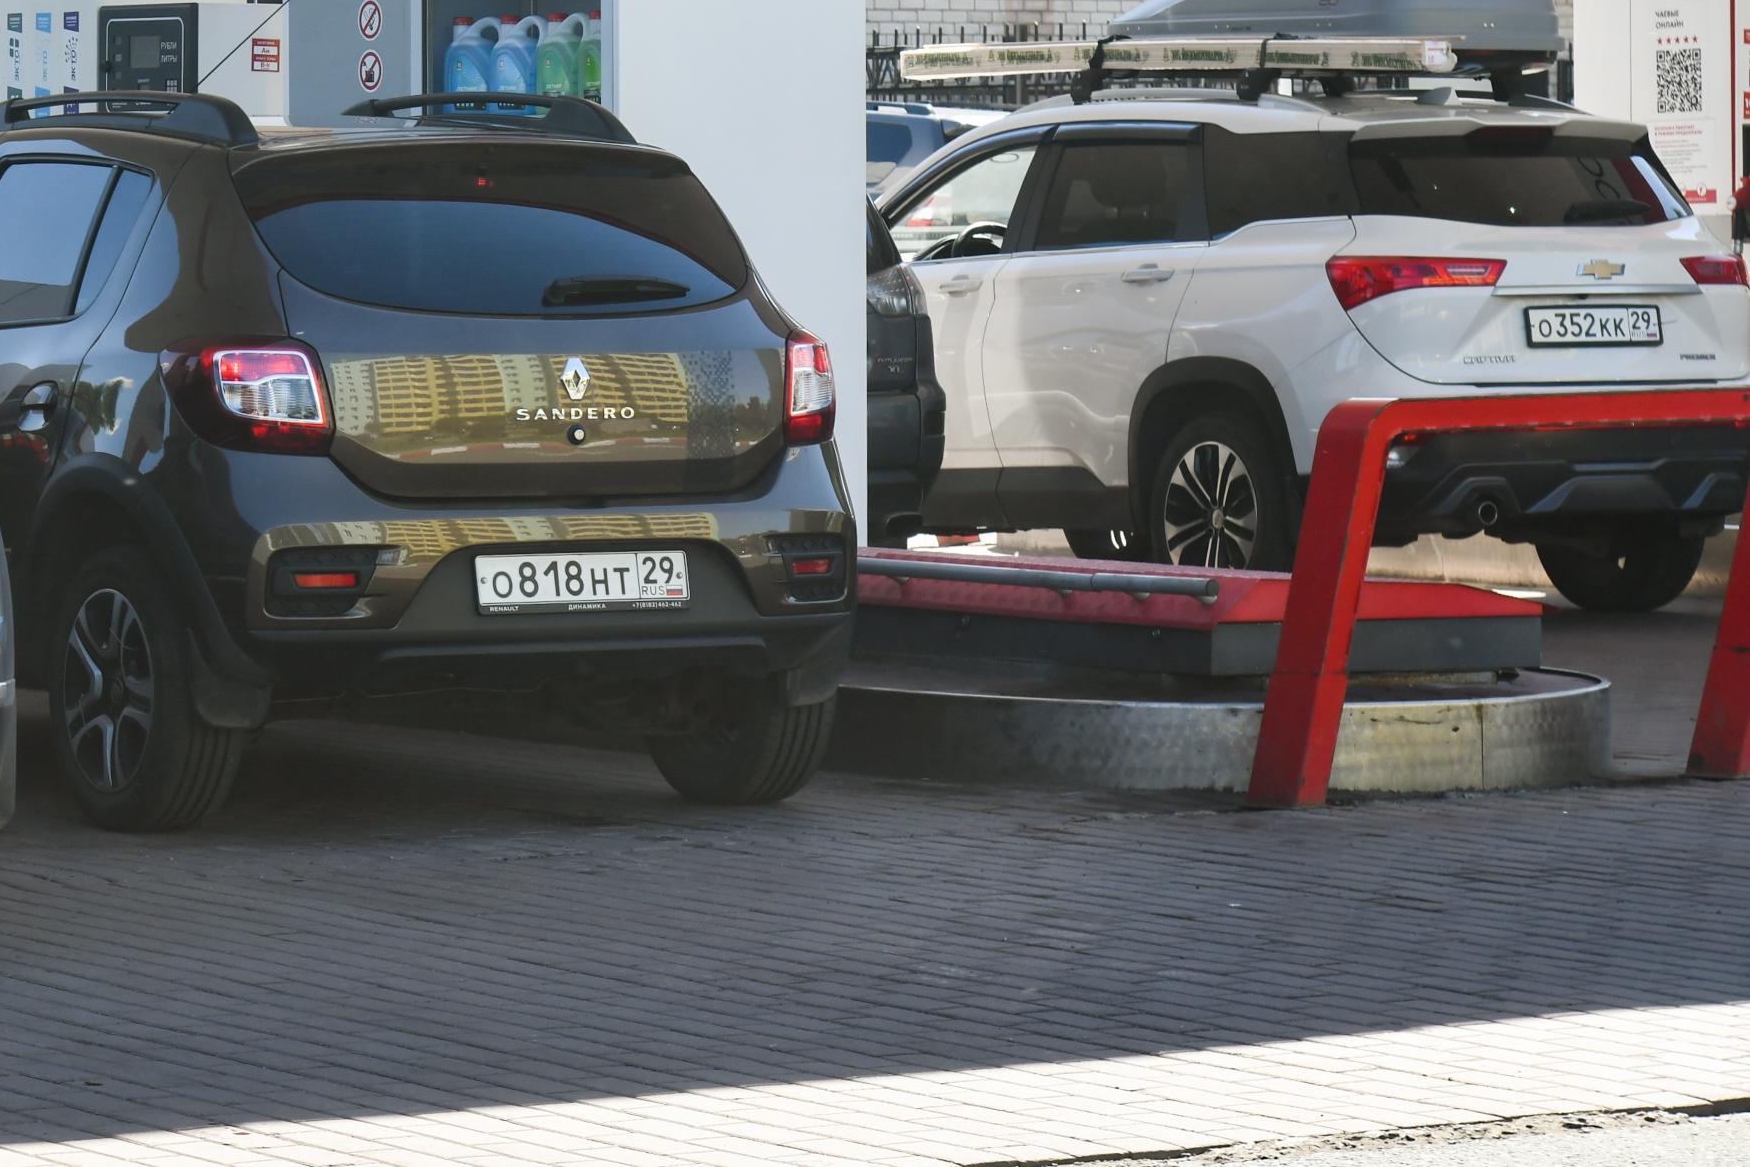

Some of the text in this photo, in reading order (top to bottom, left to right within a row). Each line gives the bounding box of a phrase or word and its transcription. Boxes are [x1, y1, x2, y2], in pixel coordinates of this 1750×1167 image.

[1655, 9, 1679, 18] ЧАЕВЫЕ
[1655, 20, 1684, 29] ОНЛАЙН
[160, 41, 177, 50] РУБЛИ
[160, 54, 178, 63] ЛИТРЫ
[1538, 311, 1651, 338] О352КК 29
[1463, 355, 1516, 365] CAPTIVA
[1679, 353, 1716, 361] PREMIER
[516, 406, 635, 421] SANDERO
[492, 556, 674, 598] О818НТ 29
[641, 585, 666, 596] RUS
[568, 603, 607, 611] ДИНАМИКА
